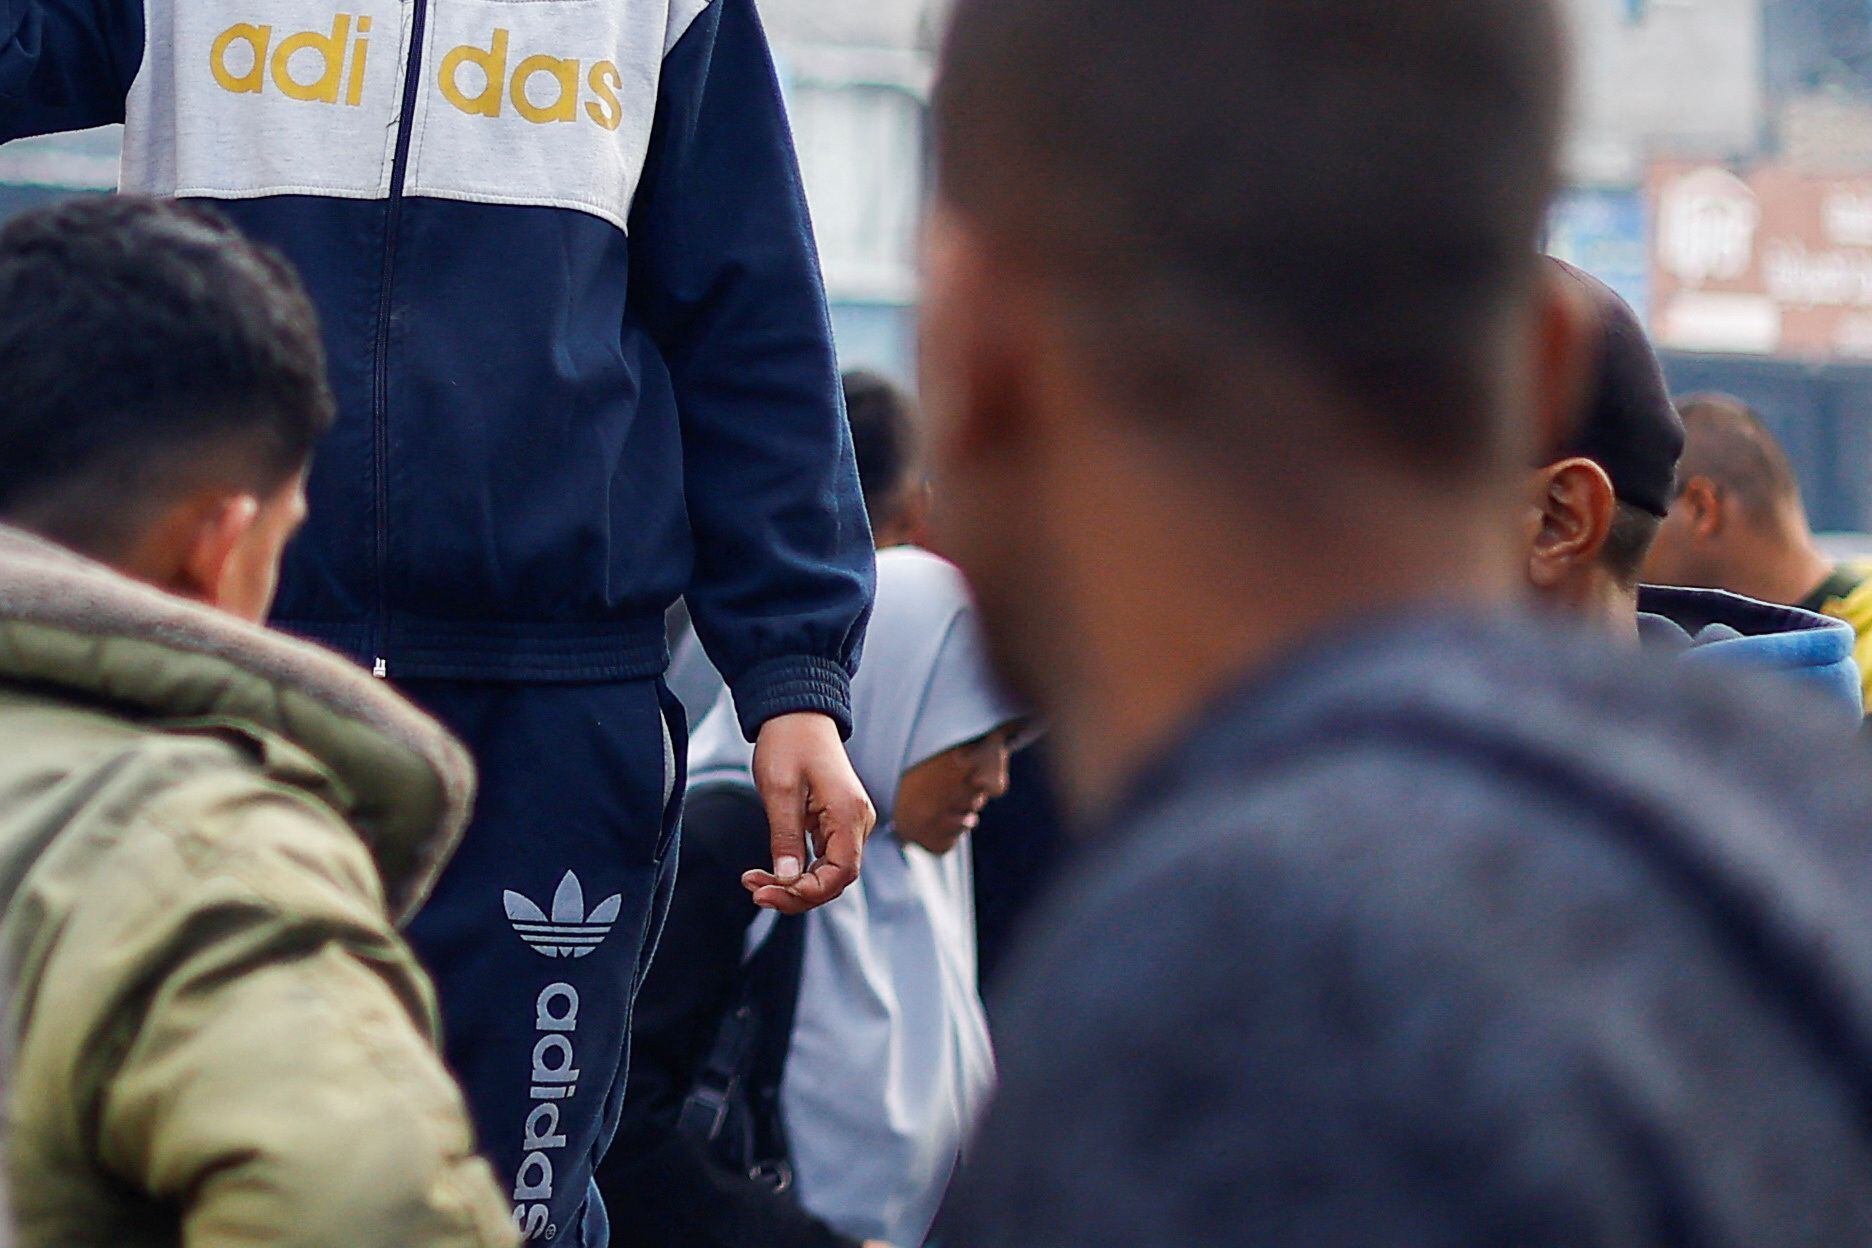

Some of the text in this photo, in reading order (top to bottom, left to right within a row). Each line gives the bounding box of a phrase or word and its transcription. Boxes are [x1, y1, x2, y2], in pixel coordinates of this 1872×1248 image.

[209, 13, 623, 132] adi das
[512, 981, 580, 1241] adidas
